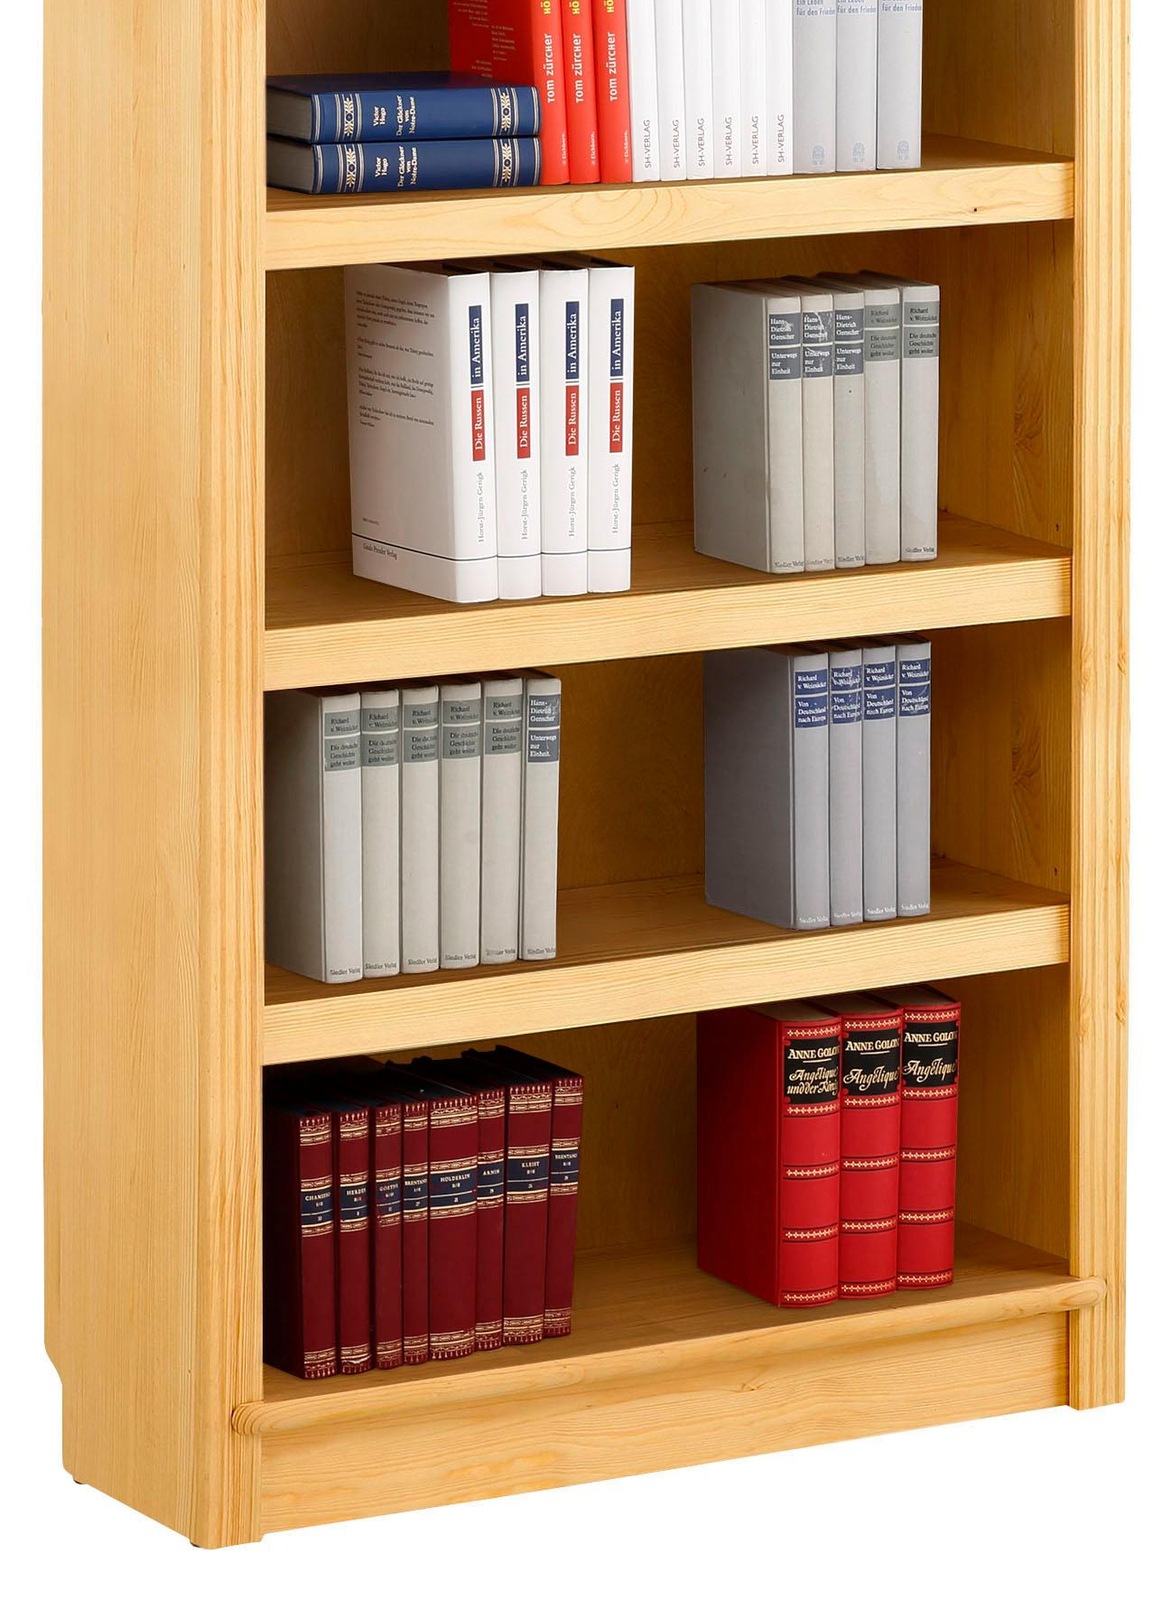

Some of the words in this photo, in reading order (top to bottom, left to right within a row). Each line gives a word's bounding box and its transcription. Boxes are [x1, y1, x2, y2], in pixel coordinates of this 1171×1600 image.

[882, 3, 891, 11] für
[517, 316, 526, 362] Amerika
[612, 311, 621, 357] Amerika
[471, 318, 480, 364] Amerika
[612, 360, 620, 370] in
[472, 368, 481, 378] in
[518, 366, 527, 376] in
[520, 395, 528, 428] Russen
[475, 433, 483, 450] Die
[520, 432, 528, 448] Die
[904, 1032, 931, 1042] ANNE
[845, 1041, 874, 1051] ANNE
[788, 1049, 816, 1059] ANNE
